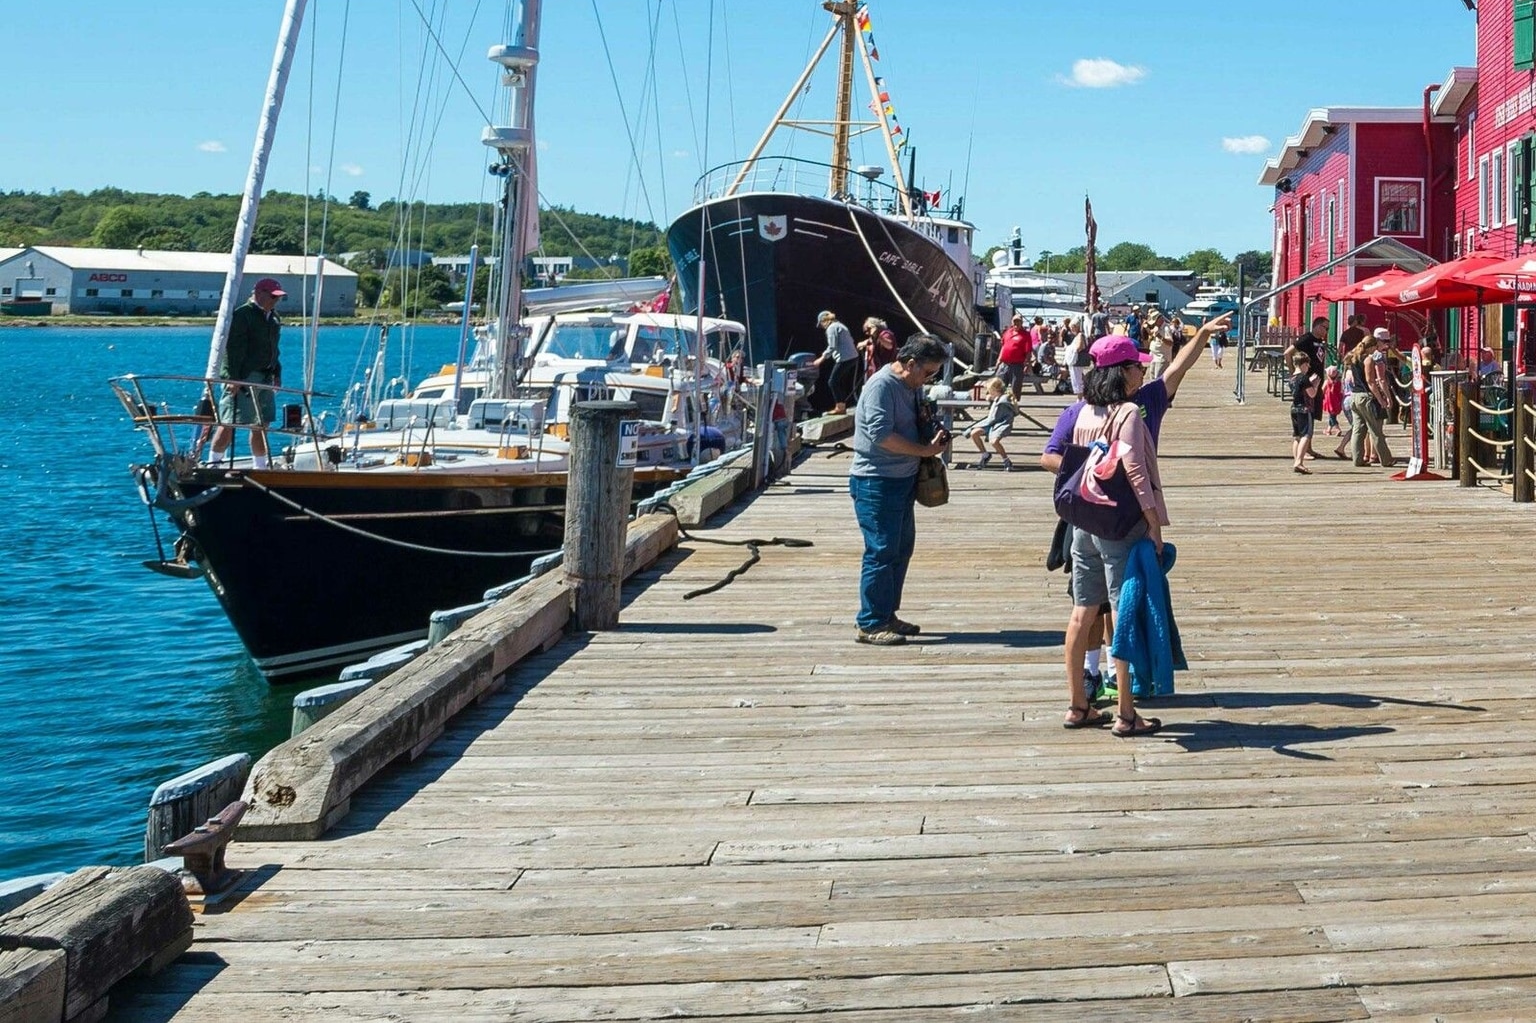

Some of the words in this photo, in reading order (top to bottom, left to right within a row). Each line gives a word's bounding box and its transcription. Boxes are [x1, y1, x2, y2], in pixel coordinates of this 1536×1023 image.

[879, 251, 901, 266] CAPE
[901, 259, 924, 275] SABLE
[89, 273, 128, 283] ABCO
[928, 270, 954, 308] 43
